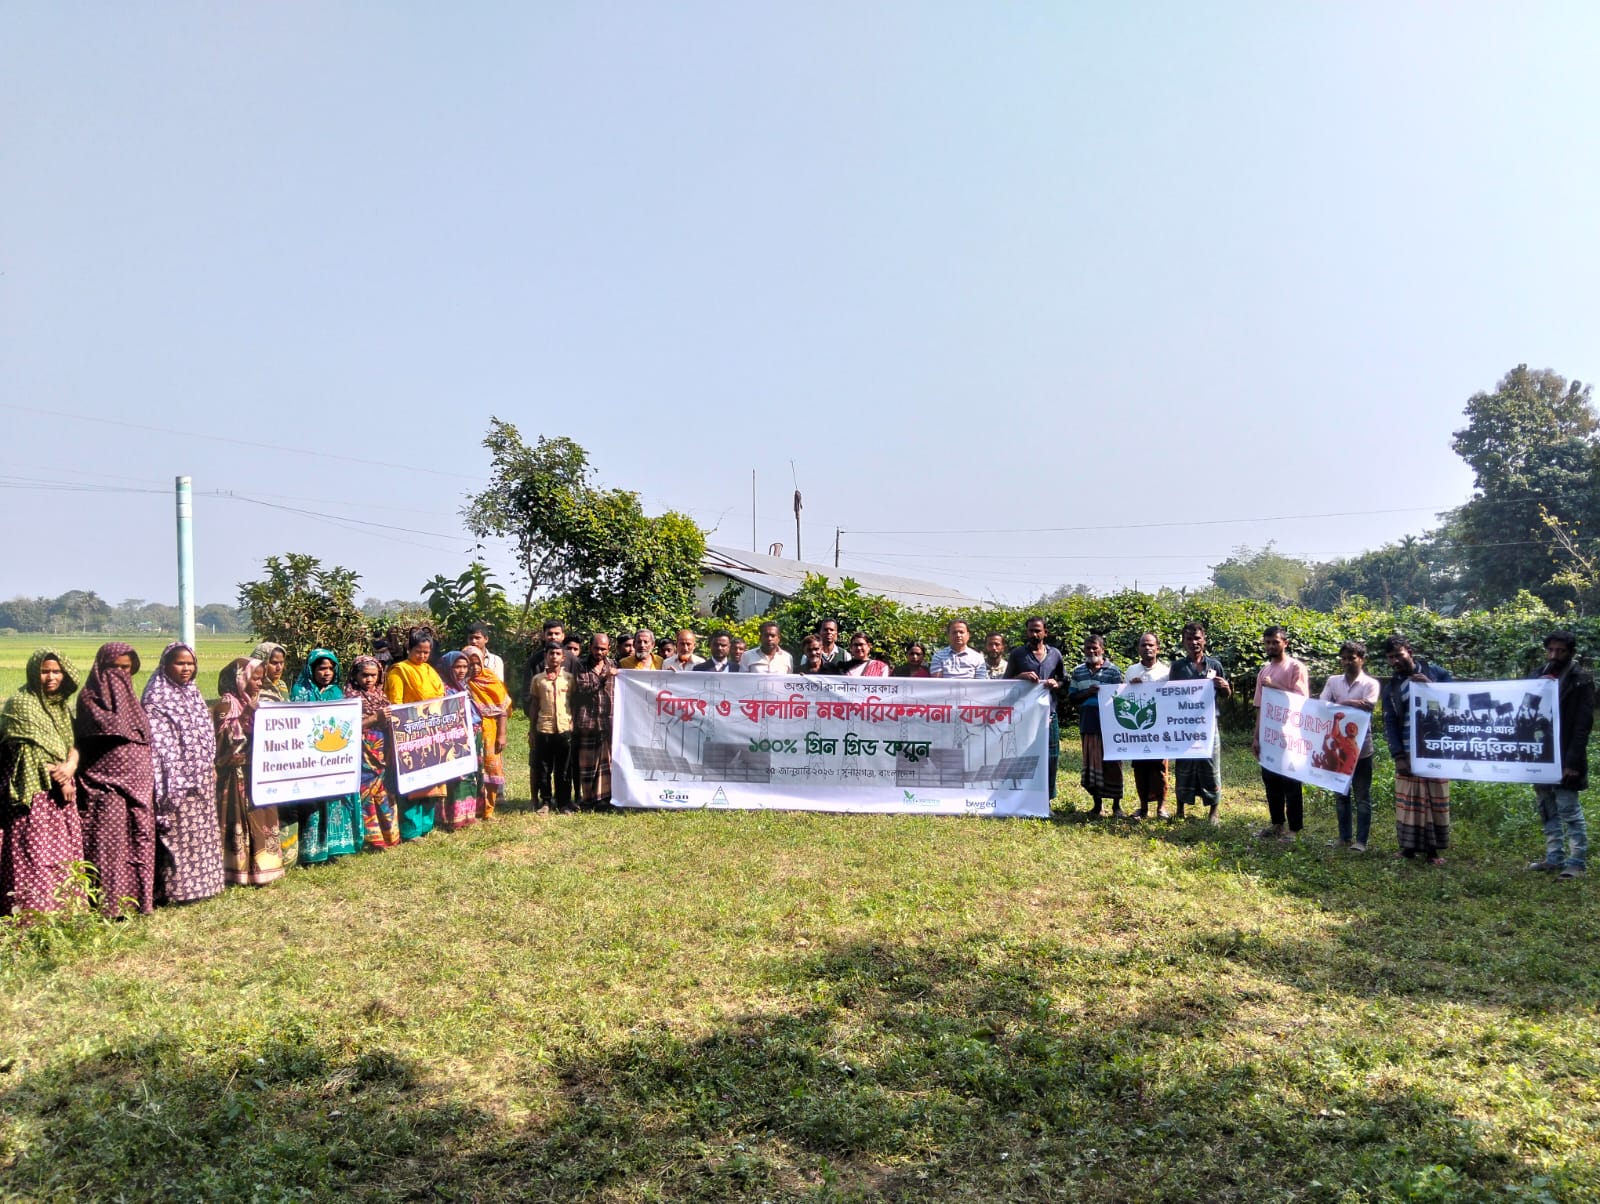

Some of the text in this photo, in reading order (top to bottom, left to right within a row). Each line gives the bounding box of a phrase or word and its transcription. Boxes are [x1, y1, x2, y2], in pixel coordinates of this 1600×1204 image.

[863, 684, 898, 694] সরকার
[656, 690, 1014, 725] বিদ্যুৎ ও জ্বালানি মহাপরিকল্পনা বদলে
[1178, 701, 1205, 710] Must
[265, 717, 301, 731] EPSMP
[1167, 716, 1206, 725] Protect
[1265, 702, 1332, 734] REFORM
[1494, 725, 1516, 734] আর
[1113, 730, 1208, 744] Climate & Lives
[1264, 727, 1312, 756] EPSMP
[263, 736, 304, 753] Must Be
[748, 731, 932, 762] ১০০% গ্রিন গ্রিড করুন
[1424, 736, 1467, 752] ফসিল
[1519, 742, 1544, 756] নয়
[263, 753, 354, 773] Renewable-Centric
[778, 766, 810, 777] জানুয়ারি
[965, 799, 997, 809] bwged
